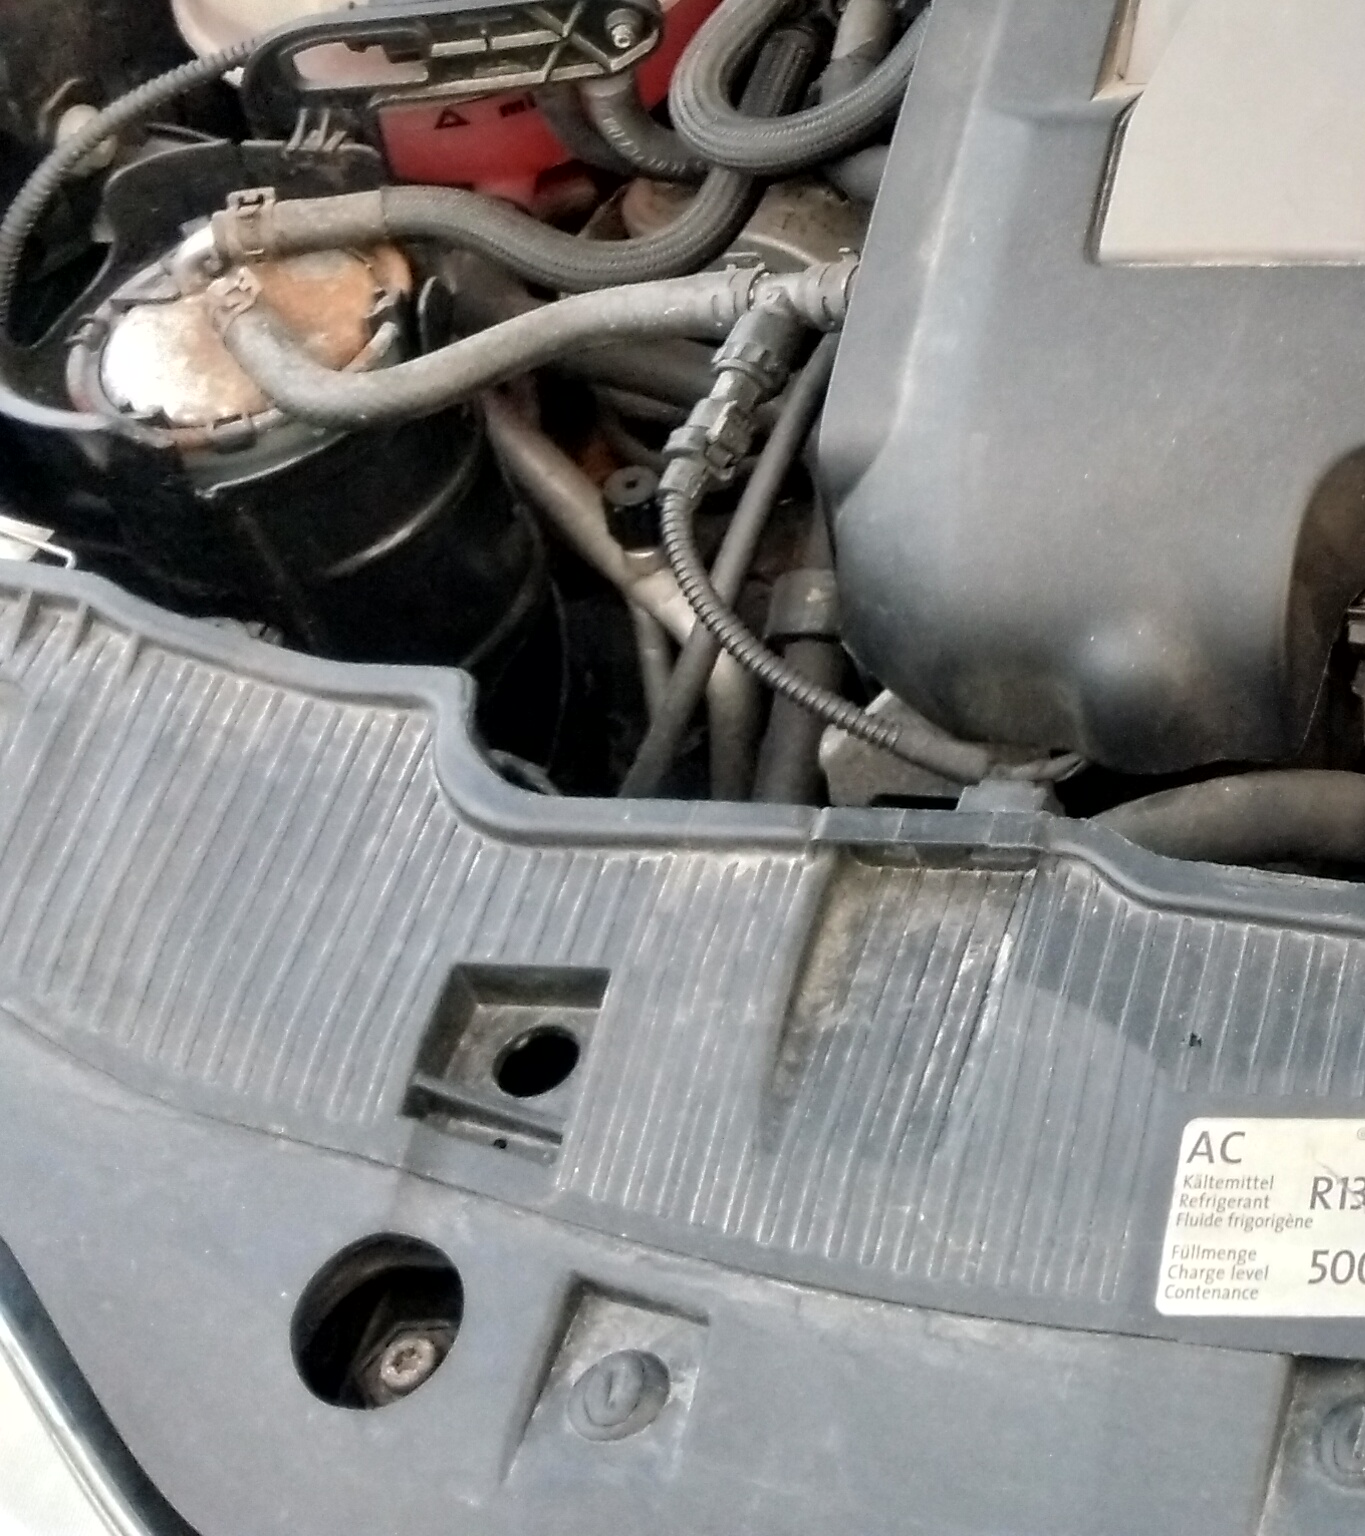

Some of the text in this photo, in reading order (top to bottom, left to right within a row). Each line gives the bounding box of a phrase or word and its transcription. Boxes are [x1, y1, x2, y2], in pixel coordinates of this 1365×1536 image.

[1186, 1131, 1246, 1164] AC
[1183, 1175, 1274, 1191] Kältemittel
[1179, 1193, 1270, 1213] Refrigerant
[1175, 1212, 1313, 1233] Fluide frigorigène
[1171, 1244, 1257, 1264] Füllmenge
[1167, 1264, 1270, 1284] Charge level
[1164, 1284, 1259, 1300] Contenance
